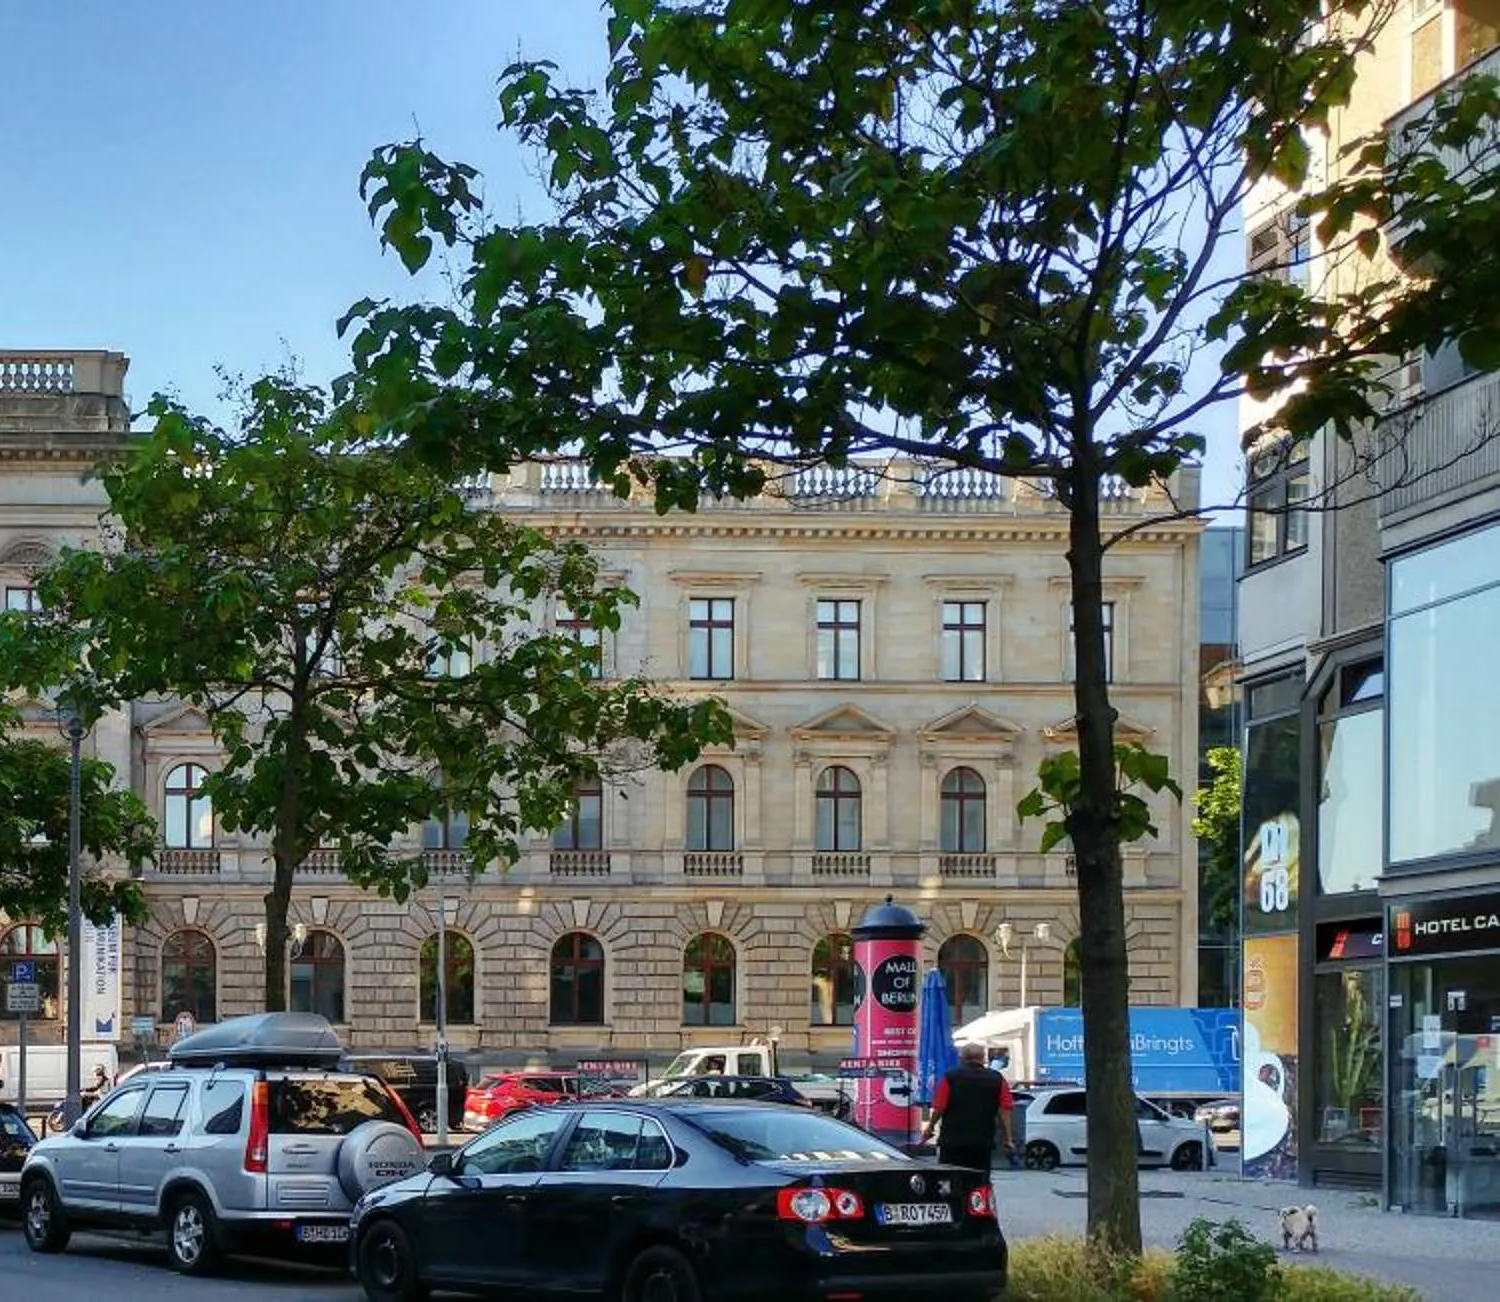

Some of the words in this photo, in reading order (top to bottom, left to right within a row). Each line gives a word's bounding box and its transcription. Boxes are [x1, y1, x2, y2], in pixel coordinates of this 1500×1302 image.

[1415, 919, 1471, 935] HOTEL
[1474, 914, 1500, 929] CA
[885, 962, 917, 974] MALL
[893, 976, 910, 989] OF
[881, 991, 918, 1005] BERLIN
[368, 1161, 416, 1169] HONDA
